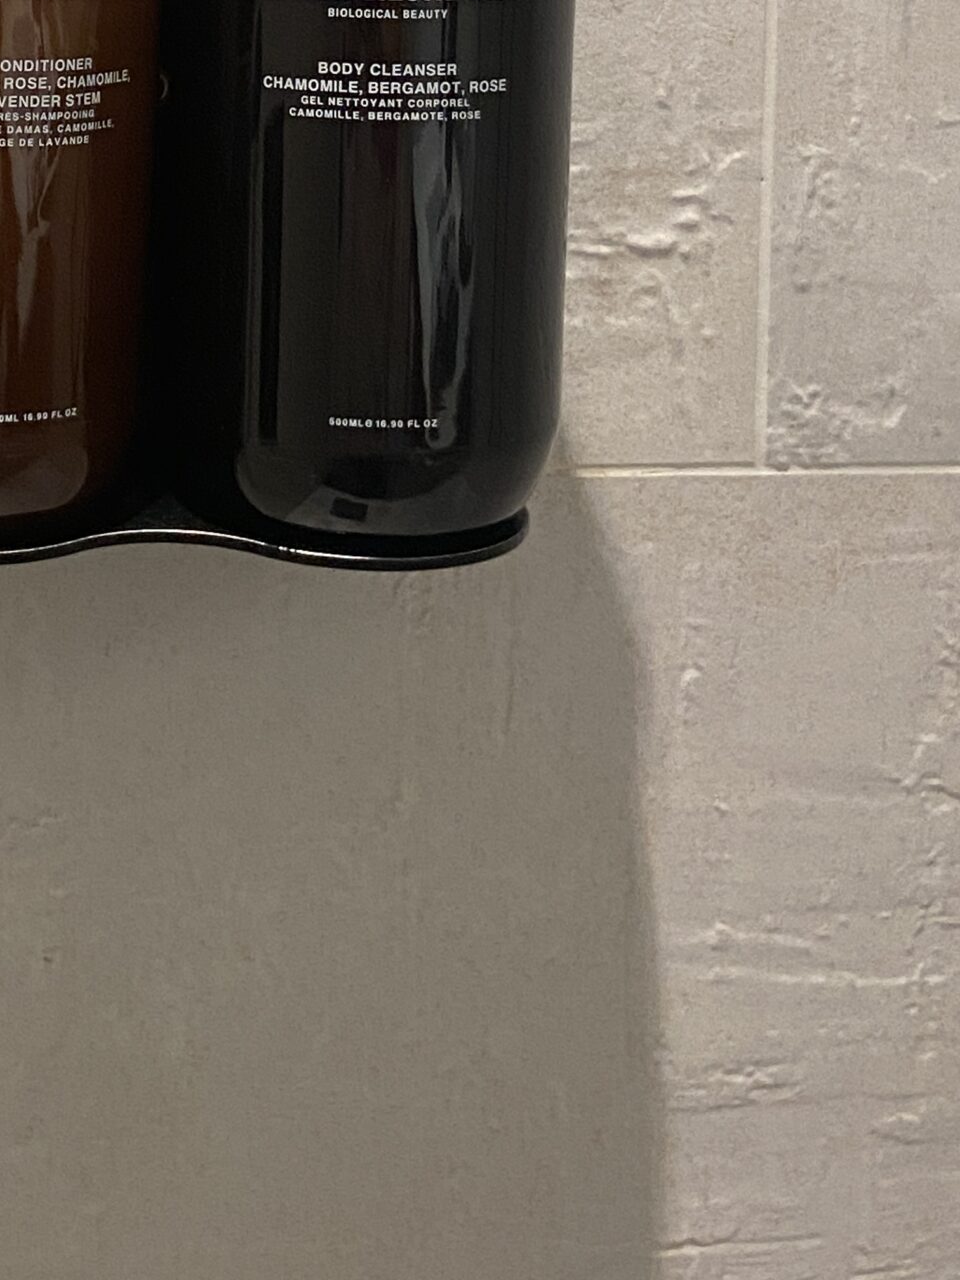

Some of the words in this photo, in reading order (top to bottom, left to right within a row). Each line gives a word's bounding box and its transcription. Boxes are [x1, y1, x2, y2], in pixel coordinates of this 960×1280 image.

[327, 7, 398, 20] BIOLOGICAL
[402, 9, 448, 20] BEAUTY
[317, 61, 365, 76] BODY
[369, 63, 458, 77] CLEANSER
[3, 76, 52, 91] ROSE,
[56, 69, 131, 89] CHAMOMILE,
[262, 75, 364, 96] CHAMOMILE,
[367, 81, 465, 97] BERGAMOT,
[469, 78, 507, 93] ROSE
[65, 91, 101, 106] STEM
[300, 95, 324, 107] GEL
[328, 96, 404, 109] NETTOYANT
[407, 97, 470, 108] CORPOREL
[288, 107, 364, 122] CAMOMILLE,
[367, 110, 448, 122] BERGAMOTE,
[451, 110, 481, 120] ROSE
[19, 138, 34, 147] DE
[38, 135, 90, 147] LAVANDE
[51, 410, 63, 419] FL
[64, 407, 77, 417] OZ
[407, 419, 421, 428] FL
[423, 419, 438, 428] OZ
